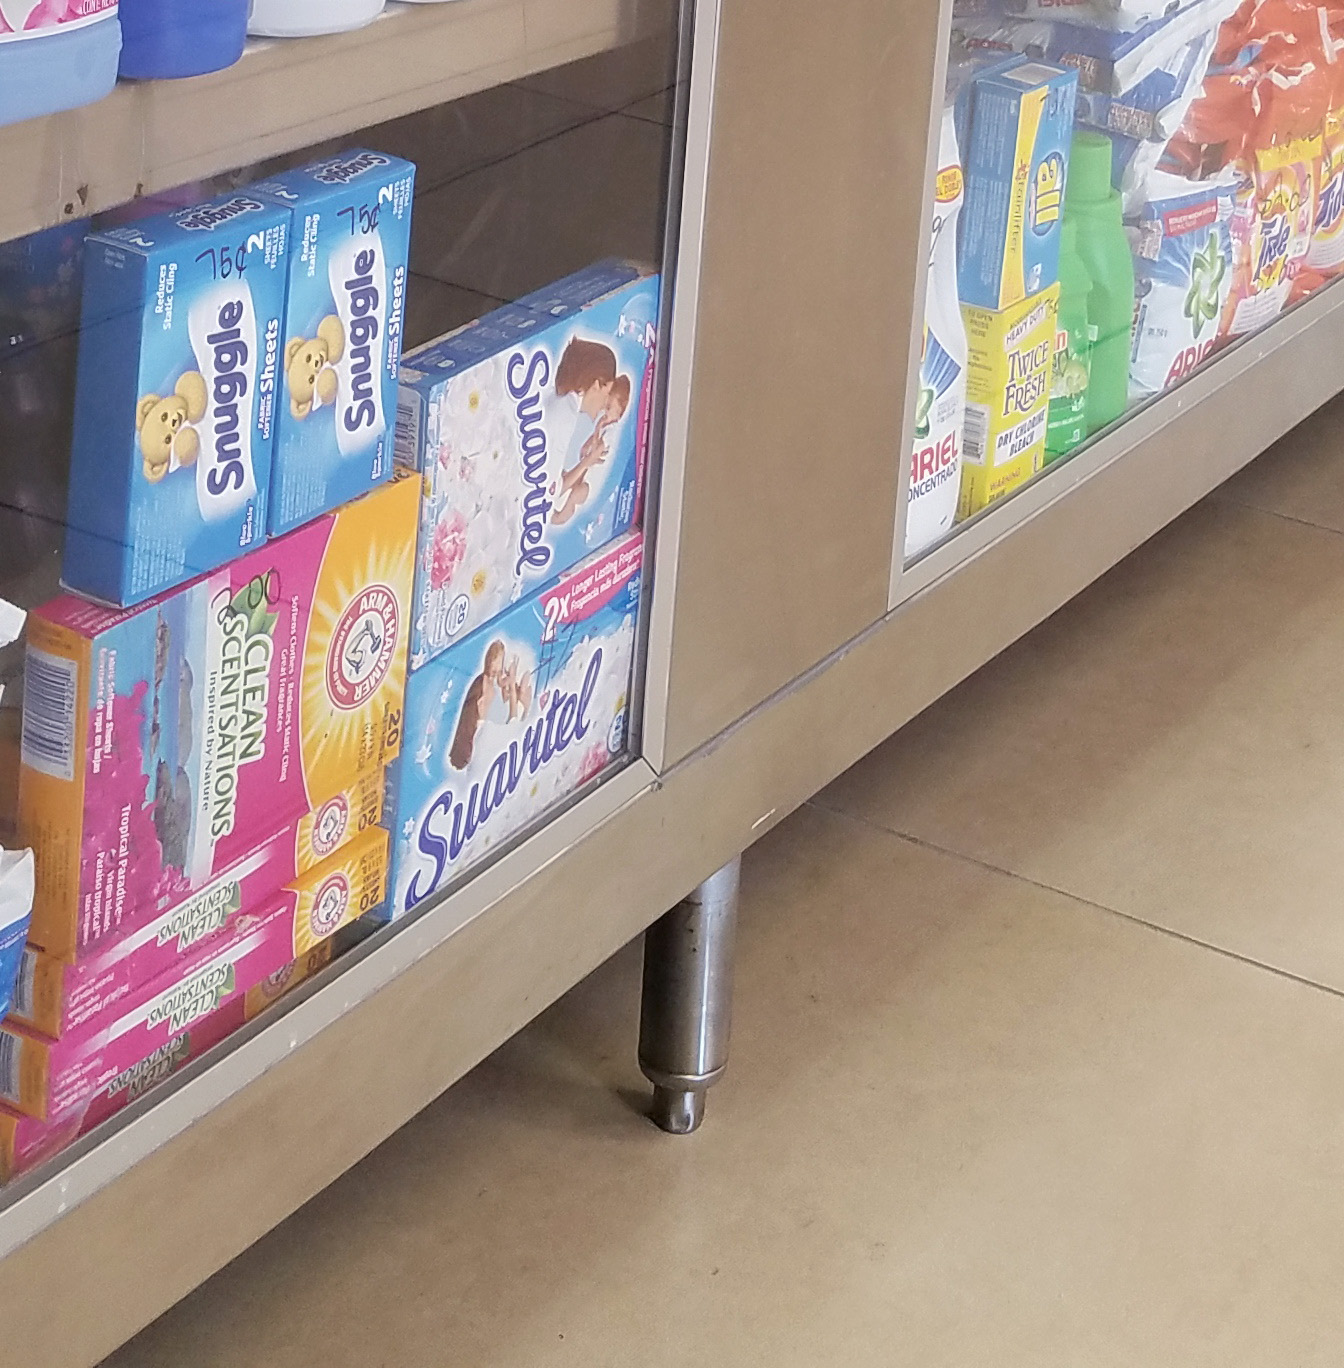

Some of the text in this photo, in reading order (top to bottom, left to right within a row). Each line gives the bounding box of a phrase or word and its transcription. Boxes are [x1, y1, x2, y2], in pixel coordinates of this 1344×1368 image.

[378, 183, 395, 205] 2
[194, 244, 248, 280] 75¢
[246, 231, 265, 256] 2
[300, 215, 312, 263] Reduces
[306, 213, 321, 277] Static Cling
[154, 264, 167, 314] Reduces
[162, 261, 178, 330] Static Cling
[387, 265, 405, 337] Sheets
[343, 247, 380, 433] Snuggle
[1005, 306, 1046, 345] HEAVY DUTY
[259, 318, 279, 393] Sheets
[1007, 339, 1050, 384] TWICE
[206, 299, 248, 496] Snuggle
[1003, 369, 1046, 417] FRESH
[506, 349, 554, 576] Suavitel
[997, 430, 1013, 450] DRY
[358, 591, 388, 615] ARM
[541, 559, 618, 642] 2X Longer Lasting
[353, 617, 396, 702] HAMMER
[206, 670, 218, 734] Inspired
[238, 635, 271, 762] CLEAN
[211, 615, 245, 837] SCENTSATIONS
[386, 708, 401, 747] 20
[200, 761, 213, 812] Nature
[405, 647, 603, 913] Suavitel
[118, 803, 132, 858] Tropical
[358, 810, 379, 831] 20
[160, 881, 236, 944] SCENTSATIONS
[358, 886, 380, 910] 20
[178, 904, 226, 953] CLEAN
[146, 962, 235, 1031] SCENTSATIONS
[168, 987, 222, 1035] CLEAN
